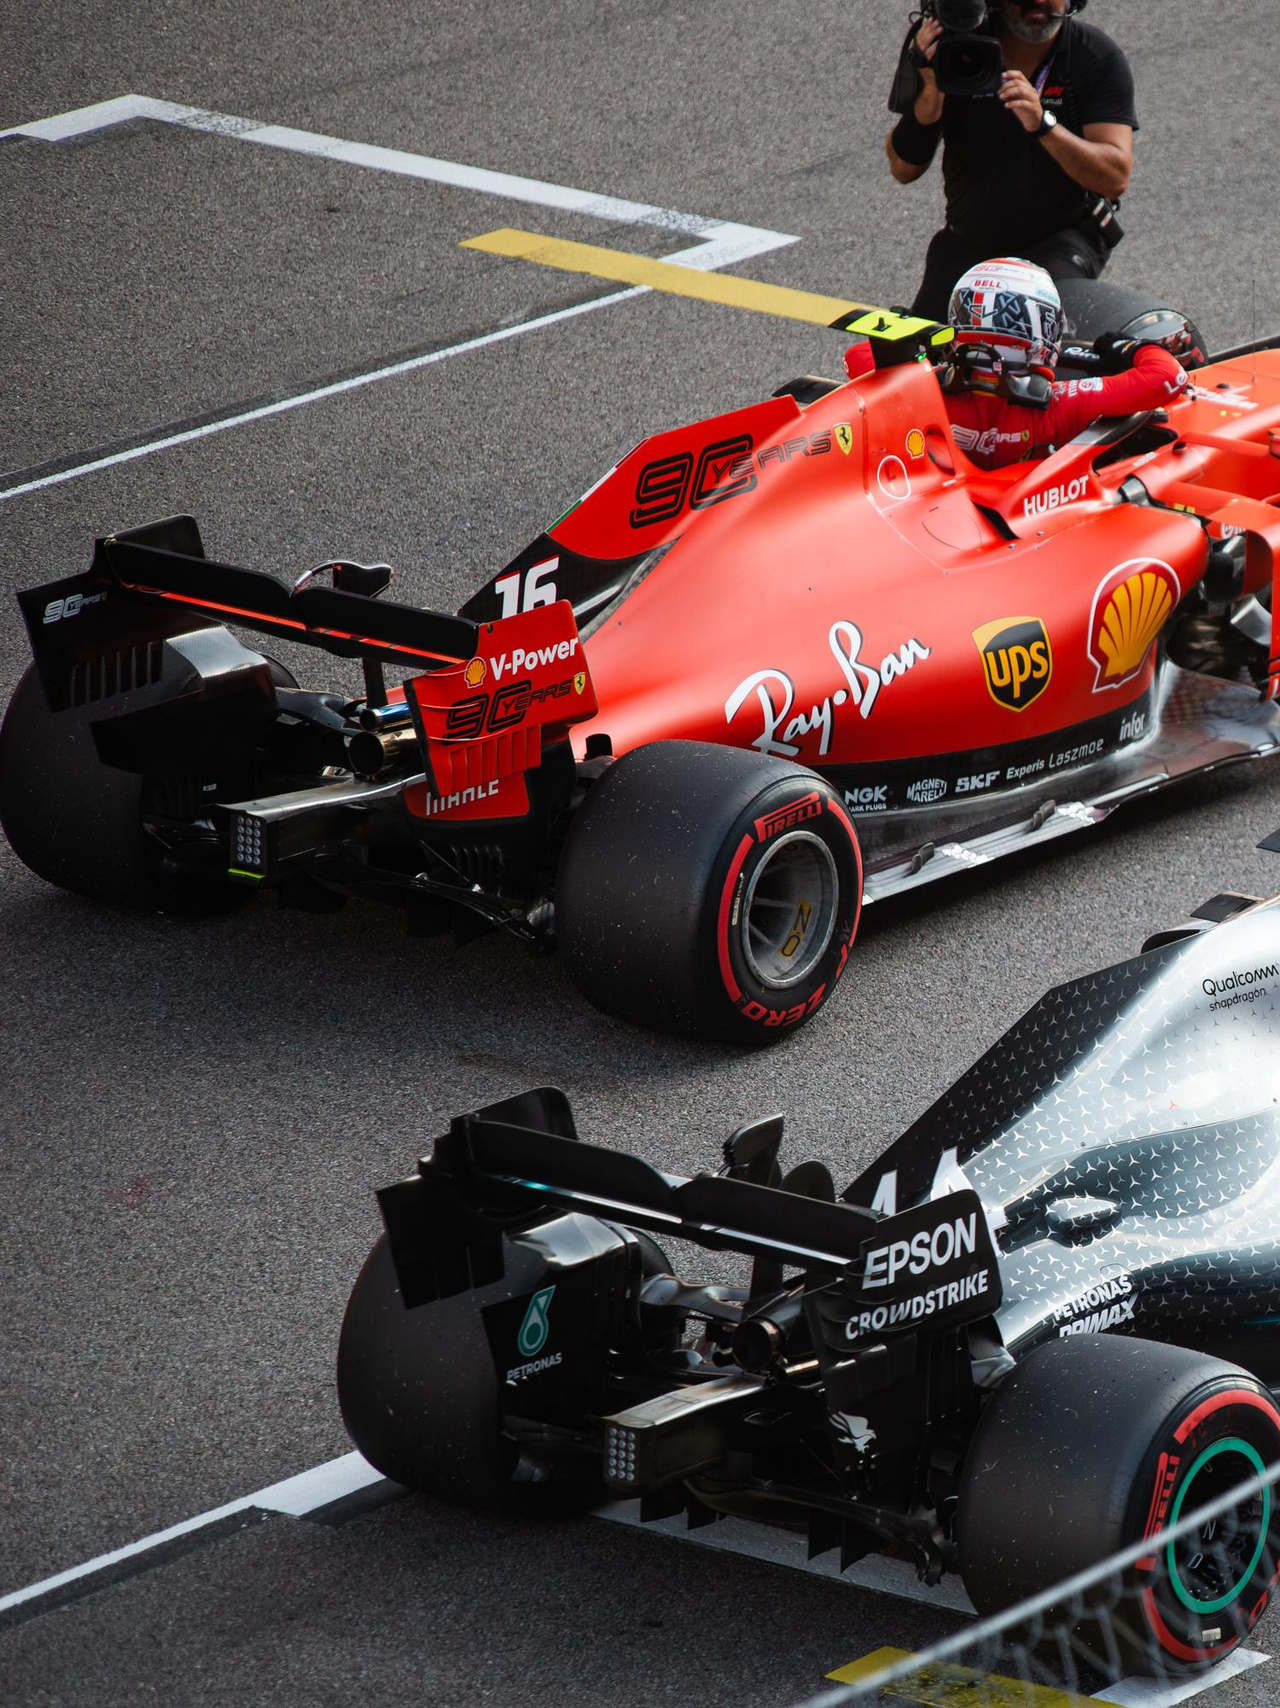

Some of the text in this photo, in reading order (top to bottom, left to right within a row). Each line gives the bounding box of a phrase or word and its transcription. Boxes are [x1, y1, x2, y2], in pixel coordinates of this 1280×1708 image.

[974, 278, 1003, 289] BELL
[712, 430, 832, 484] YEARS
[1023, 474, 1089, 518] HUBLOT
[495, 556, 560, 620] 16
[489, 636, 579, 681] V-Power
[986, 640, 1049, 699] ups
[501, 678, 574, 714] YEARS
[1119, 711, 1146, 742] infor
[955, 770, 1000, 793] SKF
[1006, 758, 1045, 780] Experis
[844, 784, 888, 805] NGK
[849, 802, 887, 812] ARK PLUGS
[754, 791, 822, 844] PIRELLI
[1202, 964, 1280, 996] Qualcomm
[1209, 986, 1267, 1012] snapdragon
[861, 1211, 977, 1290] EPSON
[845, 1268, 989, 1340] CROWDSTRIKE
[1052, 1274, 1133, 1321] PETRONAS
[506, 1352, 562, 1381] PETRONAS
[1134, 1451, 1180, 1572] PRELLI
